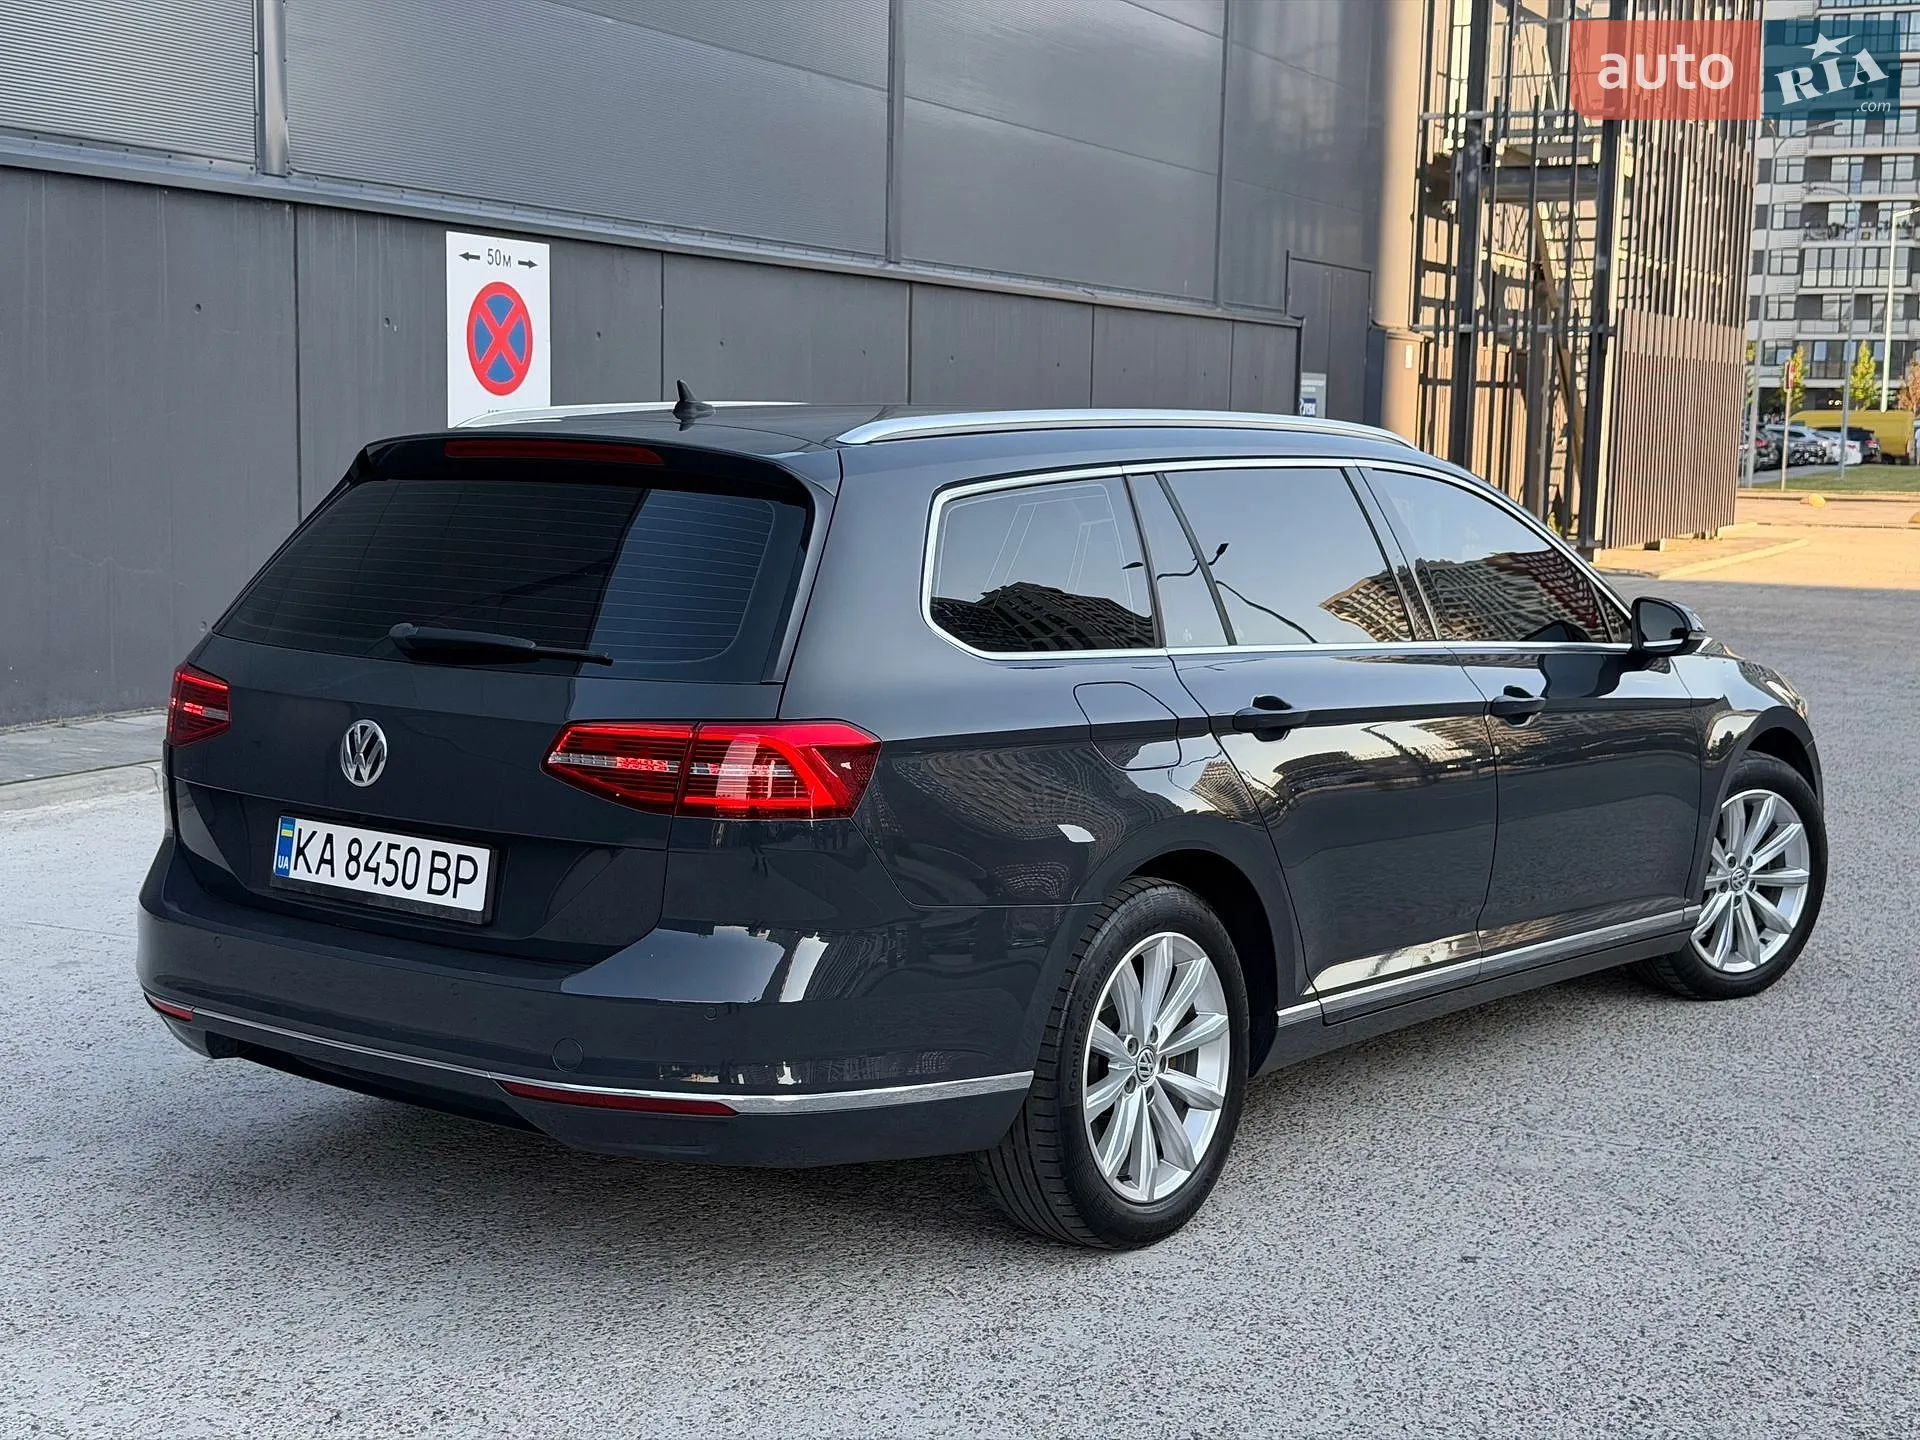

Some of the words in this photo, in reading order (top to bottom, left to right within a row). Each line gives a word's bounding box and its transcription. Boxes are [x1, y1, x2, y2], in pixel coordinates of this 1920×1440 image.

[278, 855, 289, 870] UA
[293, 828, 335, 878] KA
[344, 837, 421, 891] 8450
[426, 850, 478, 899] BP
